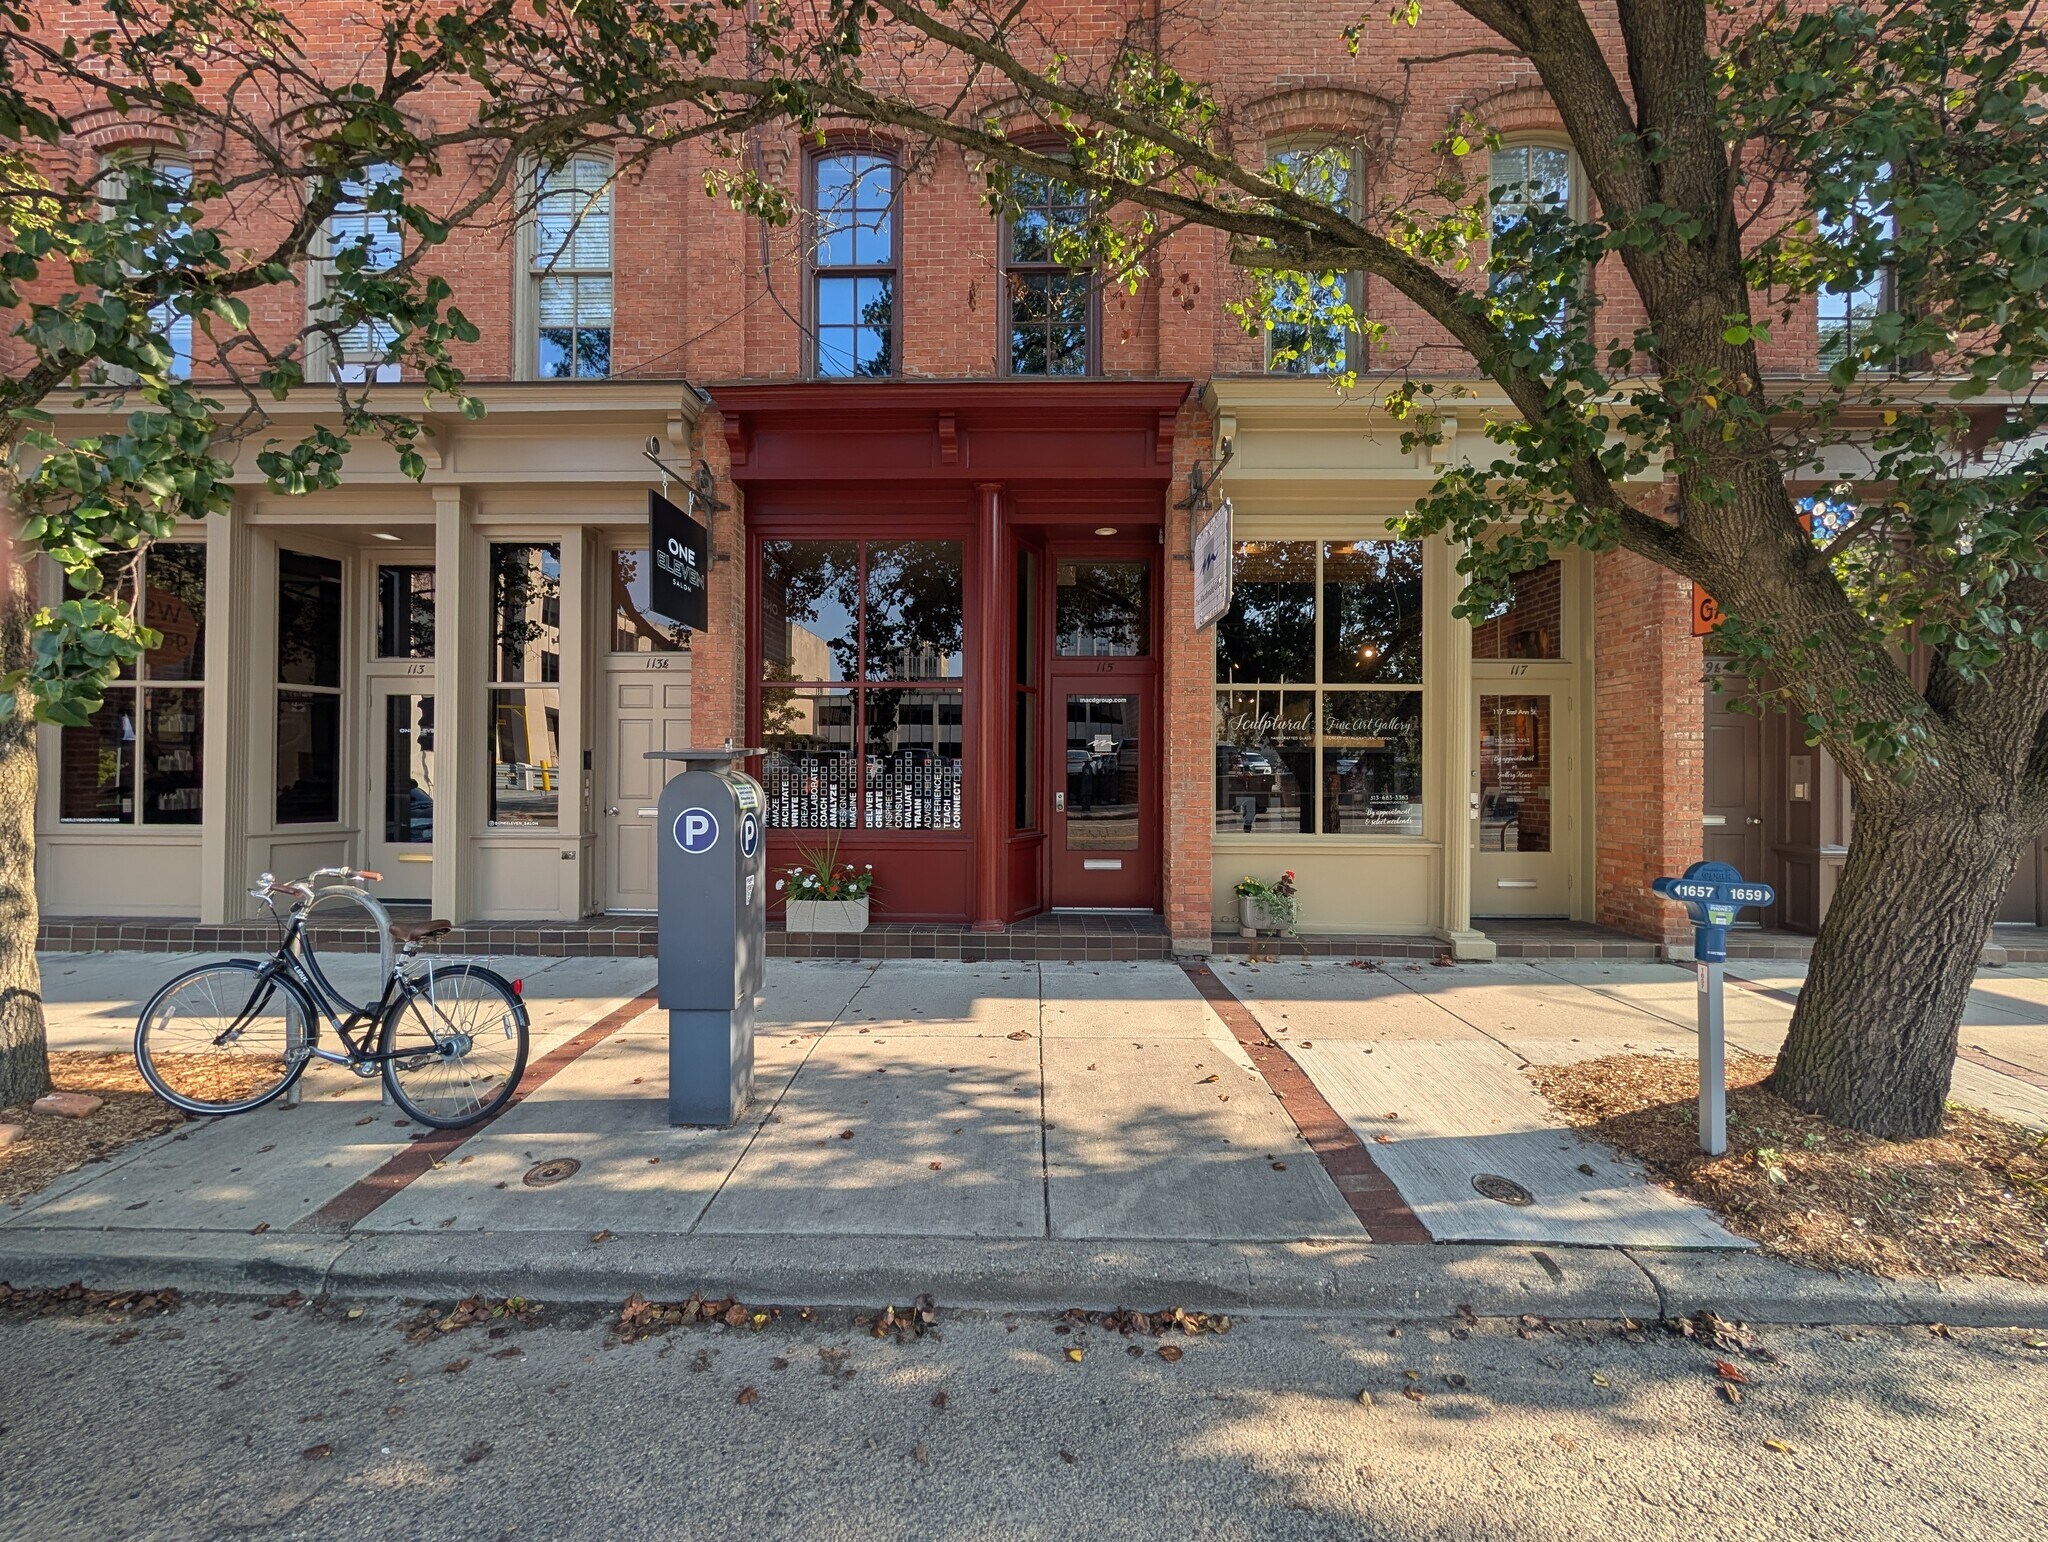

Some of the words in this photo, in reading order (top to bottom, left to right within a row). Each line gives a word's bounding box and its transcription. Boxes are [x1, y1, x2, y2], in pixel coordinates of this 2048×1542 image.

[668, 537, 696, 567] ONE
[657, 549, 705, 590] ELEVEN
[672, 578, 692, 593] SALON
[407, 664, 426, 675] 113
[1096, 662, 1115, 673] 115
[1510, 664, 1529, 676] 117
[1228, 711, 1314, 737] Sculptural
[1325, 716, 1351, 732] Fine
[1352, 717, 1374, 731] Art
[1374, 716, 1411, 737] Gallery
[781, 780, 789, 828] FACILITATE
[791, 796, 799, 828] WRITE
[810, 765, 818, 828] COLLABORATE
[829, 783, 838, 828] ANALYZE
[839, 796, 847, 828] DESIGN
[849, 792, 857, 828] IMAGINE
[865, 791, 874, 828] DELIVER
[875, 790, 883, 828] CREATE
[885, 795, 893, 828] INSPIRE
[894, 788, 903, 828] CONSULT
[904, 784, 913, 828] EVALUATE
[933, 773, 941, 828] EXPERIENCE
[952, 782, 961, 829] CONNECT
[772, 798, 780, 828] AMAZE
[800, 797, 808, 828] DREAM
[820, 797, 828, 828] COACH
[914, 798, 922, 829] TRAIN
[923, 798, 932, 829] ADVISE
[943, 799, 951, 829] TEACH
[685, 815, 710, 846] P
[745, 820, 755, 851] P
[1681, 885, 1714, 898] 1657
[1730, 888, 1762, 901] 1659
[293, 965, 309, 984] LINUS
